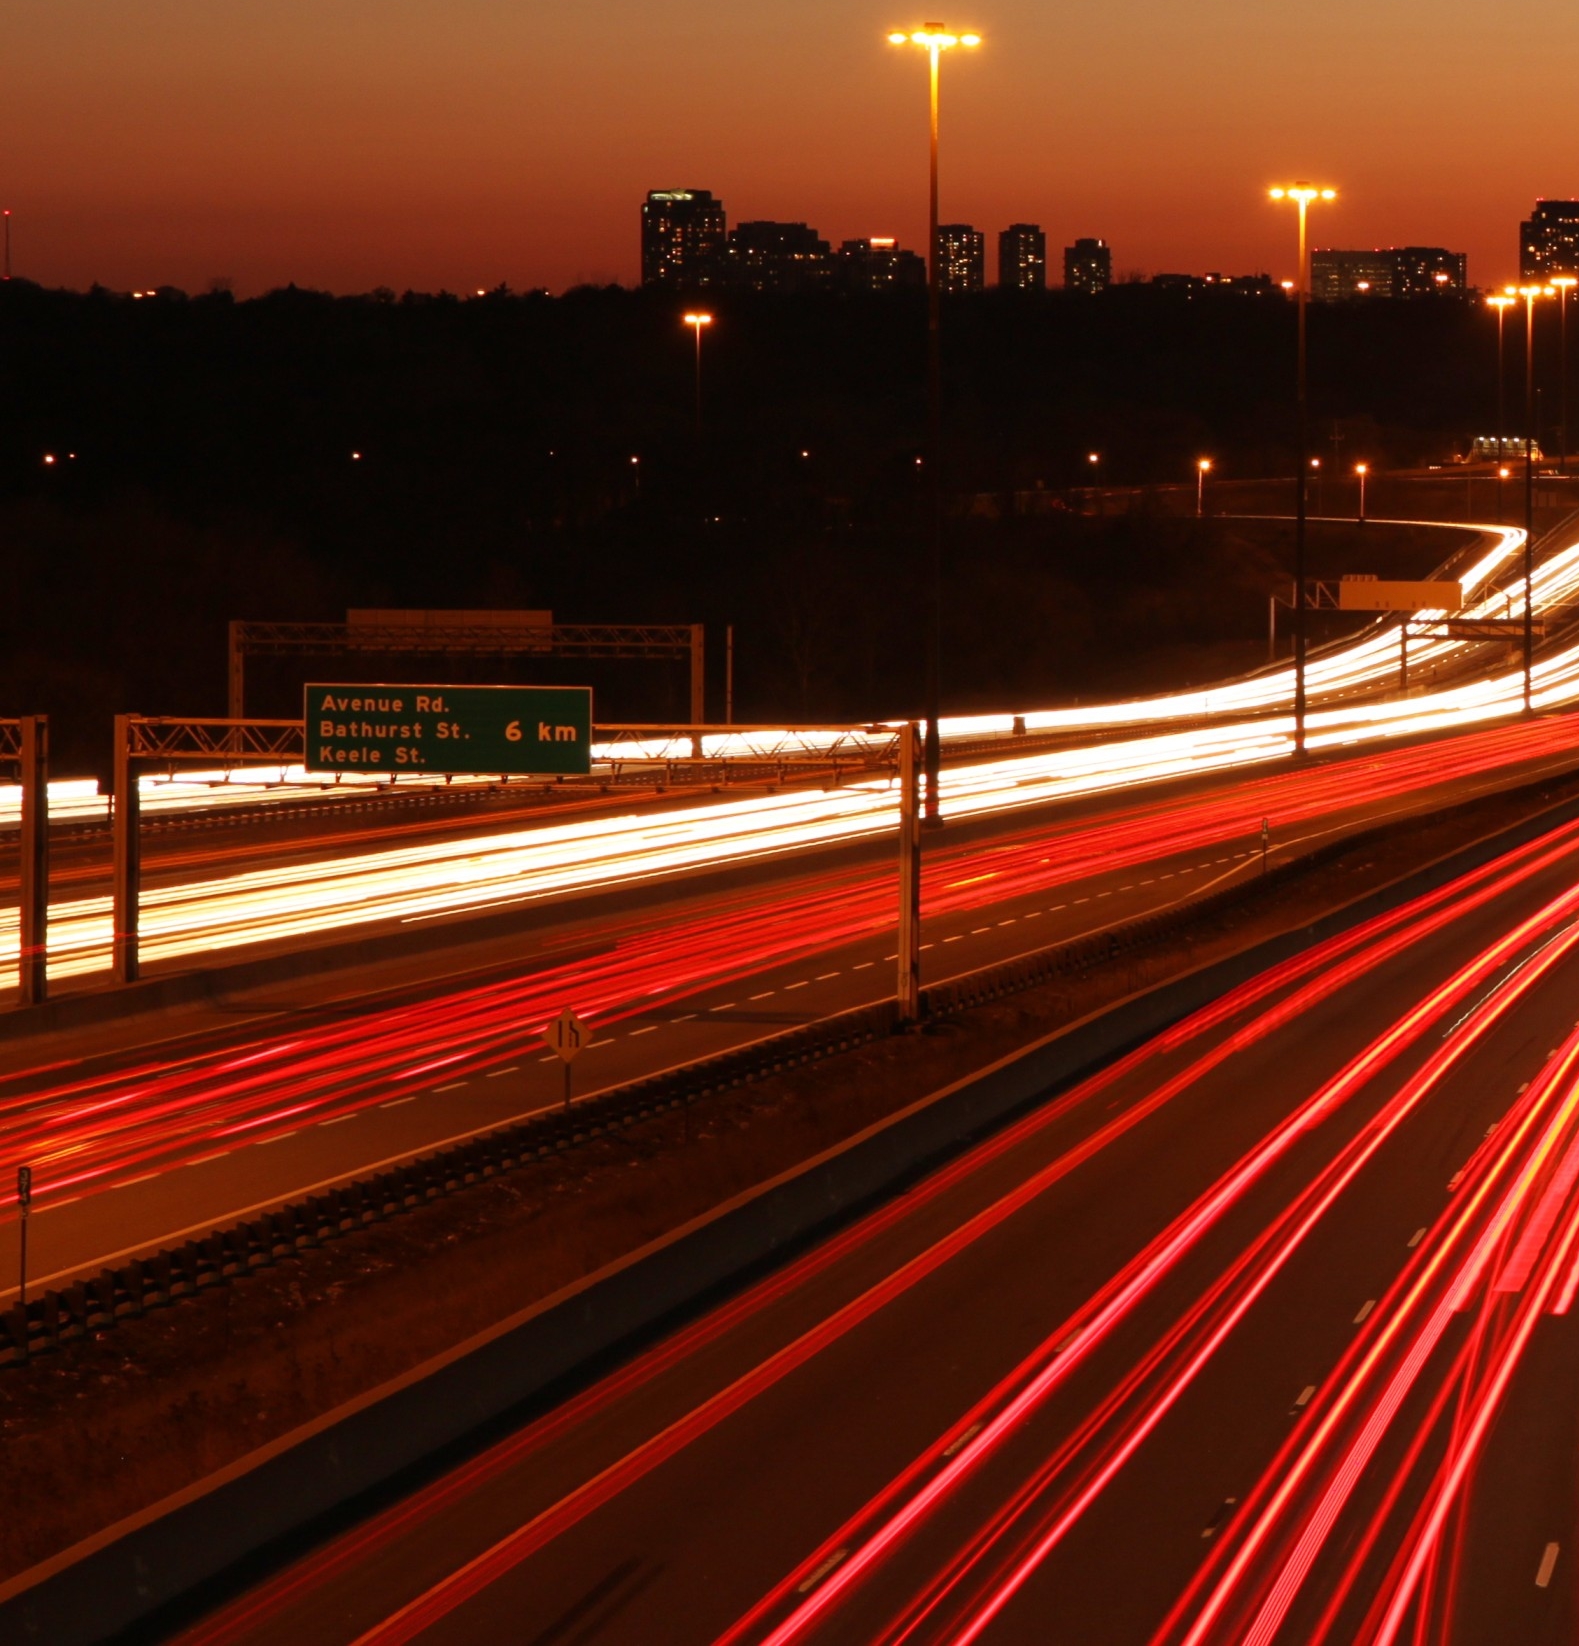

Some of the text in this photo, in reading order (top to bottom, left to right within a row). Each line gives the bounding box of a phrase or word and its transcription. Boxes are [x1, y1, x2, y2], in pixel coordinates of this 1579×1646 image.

[321, 695, 450, 712] Avenue Rd.
[320, 721, 576, 742] Bathurst St. 6 km
[320, 746, 426, 764] Keele St.
